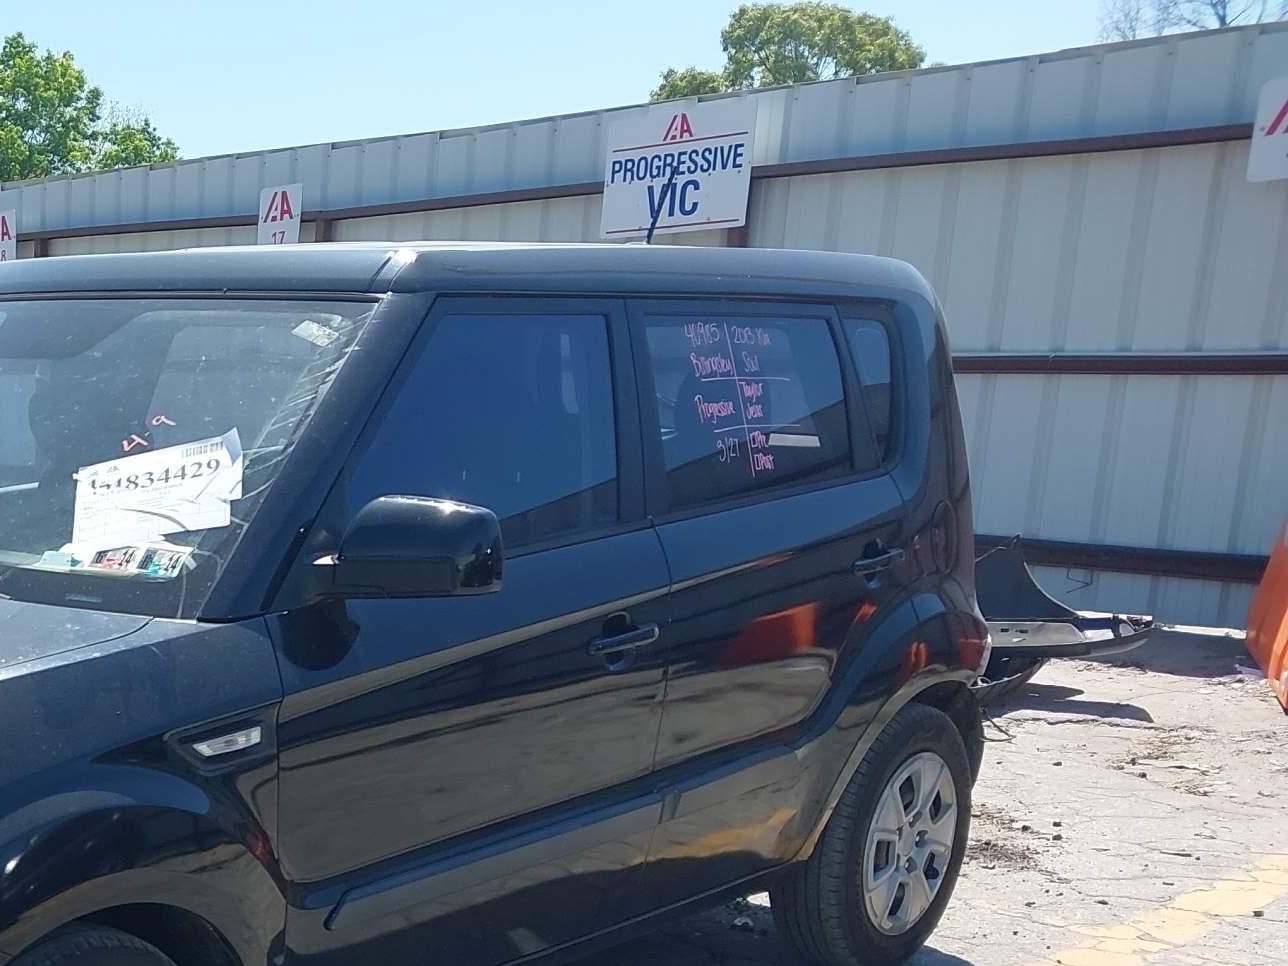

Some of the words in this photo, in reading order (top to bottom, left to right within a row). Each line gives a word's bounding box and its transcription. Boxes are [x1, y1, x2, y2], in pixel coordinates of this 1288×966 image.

[610, 142, 745, 184] PROGRESSIVE
[646, 178, 701, 220] VIC
[271, 231, 287, 245] 17
